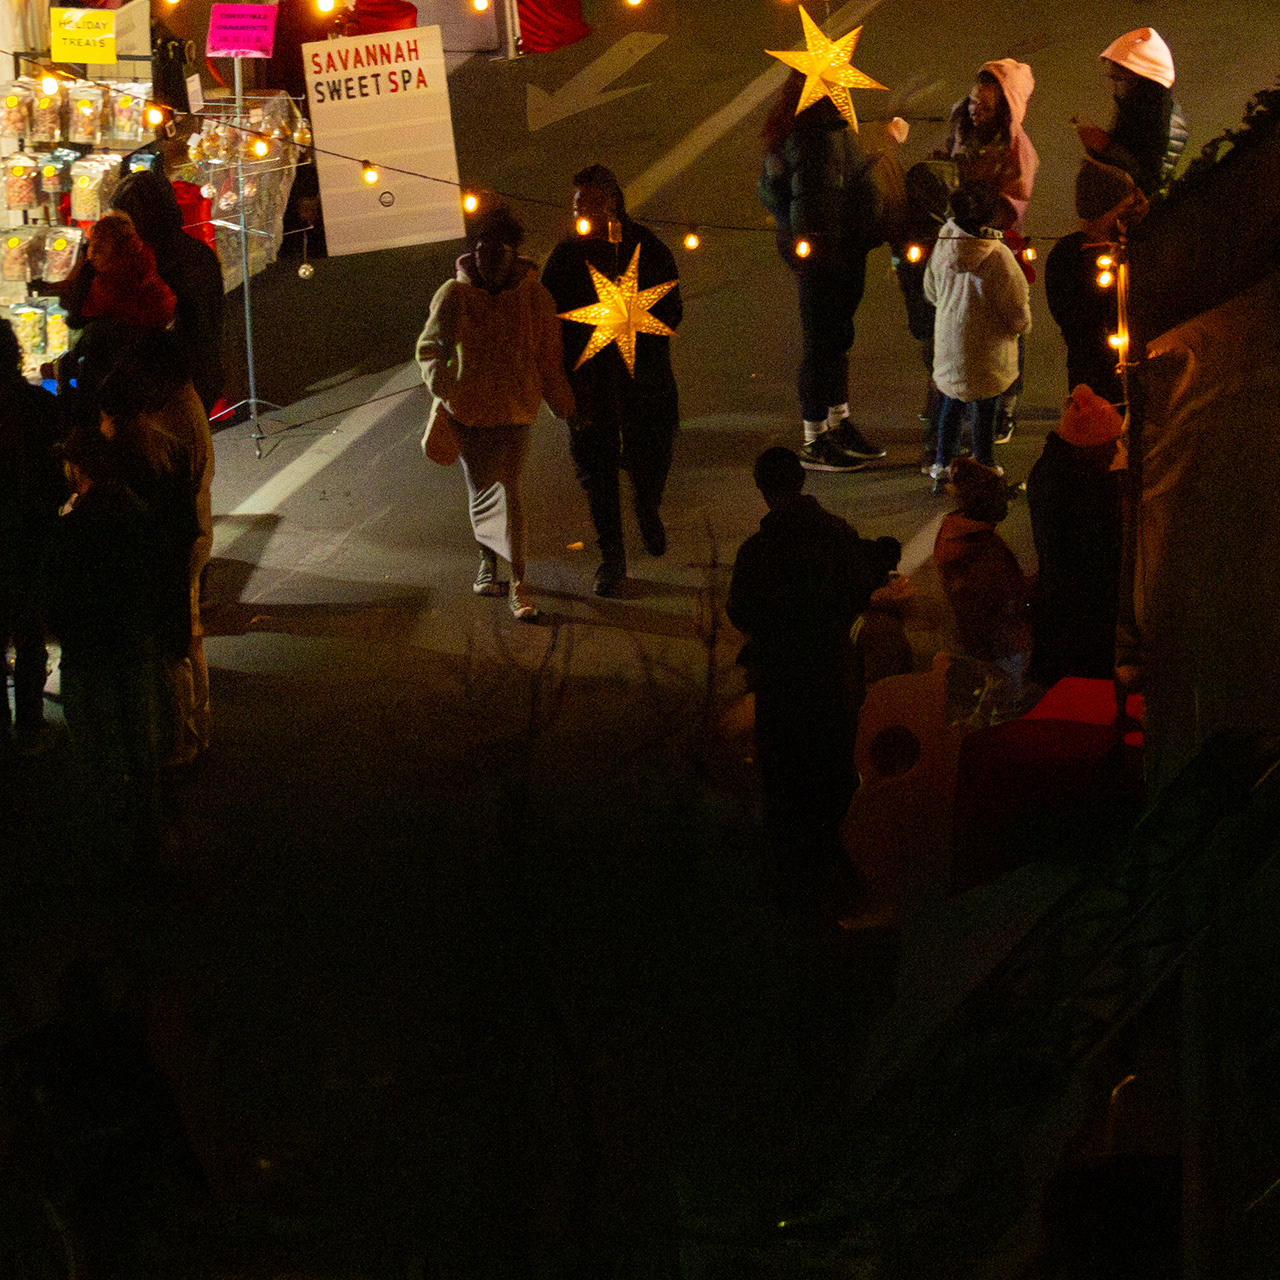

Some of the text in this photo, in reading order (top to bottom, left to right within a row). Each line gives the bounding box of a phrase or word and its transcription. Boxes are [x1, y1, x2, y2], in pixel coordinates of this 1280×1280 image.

[62, 37, 106, 48] TREATS
[311, 39, 420, 75] SAVANNAH
[314, 66, 429, 104] SWEET SPA
